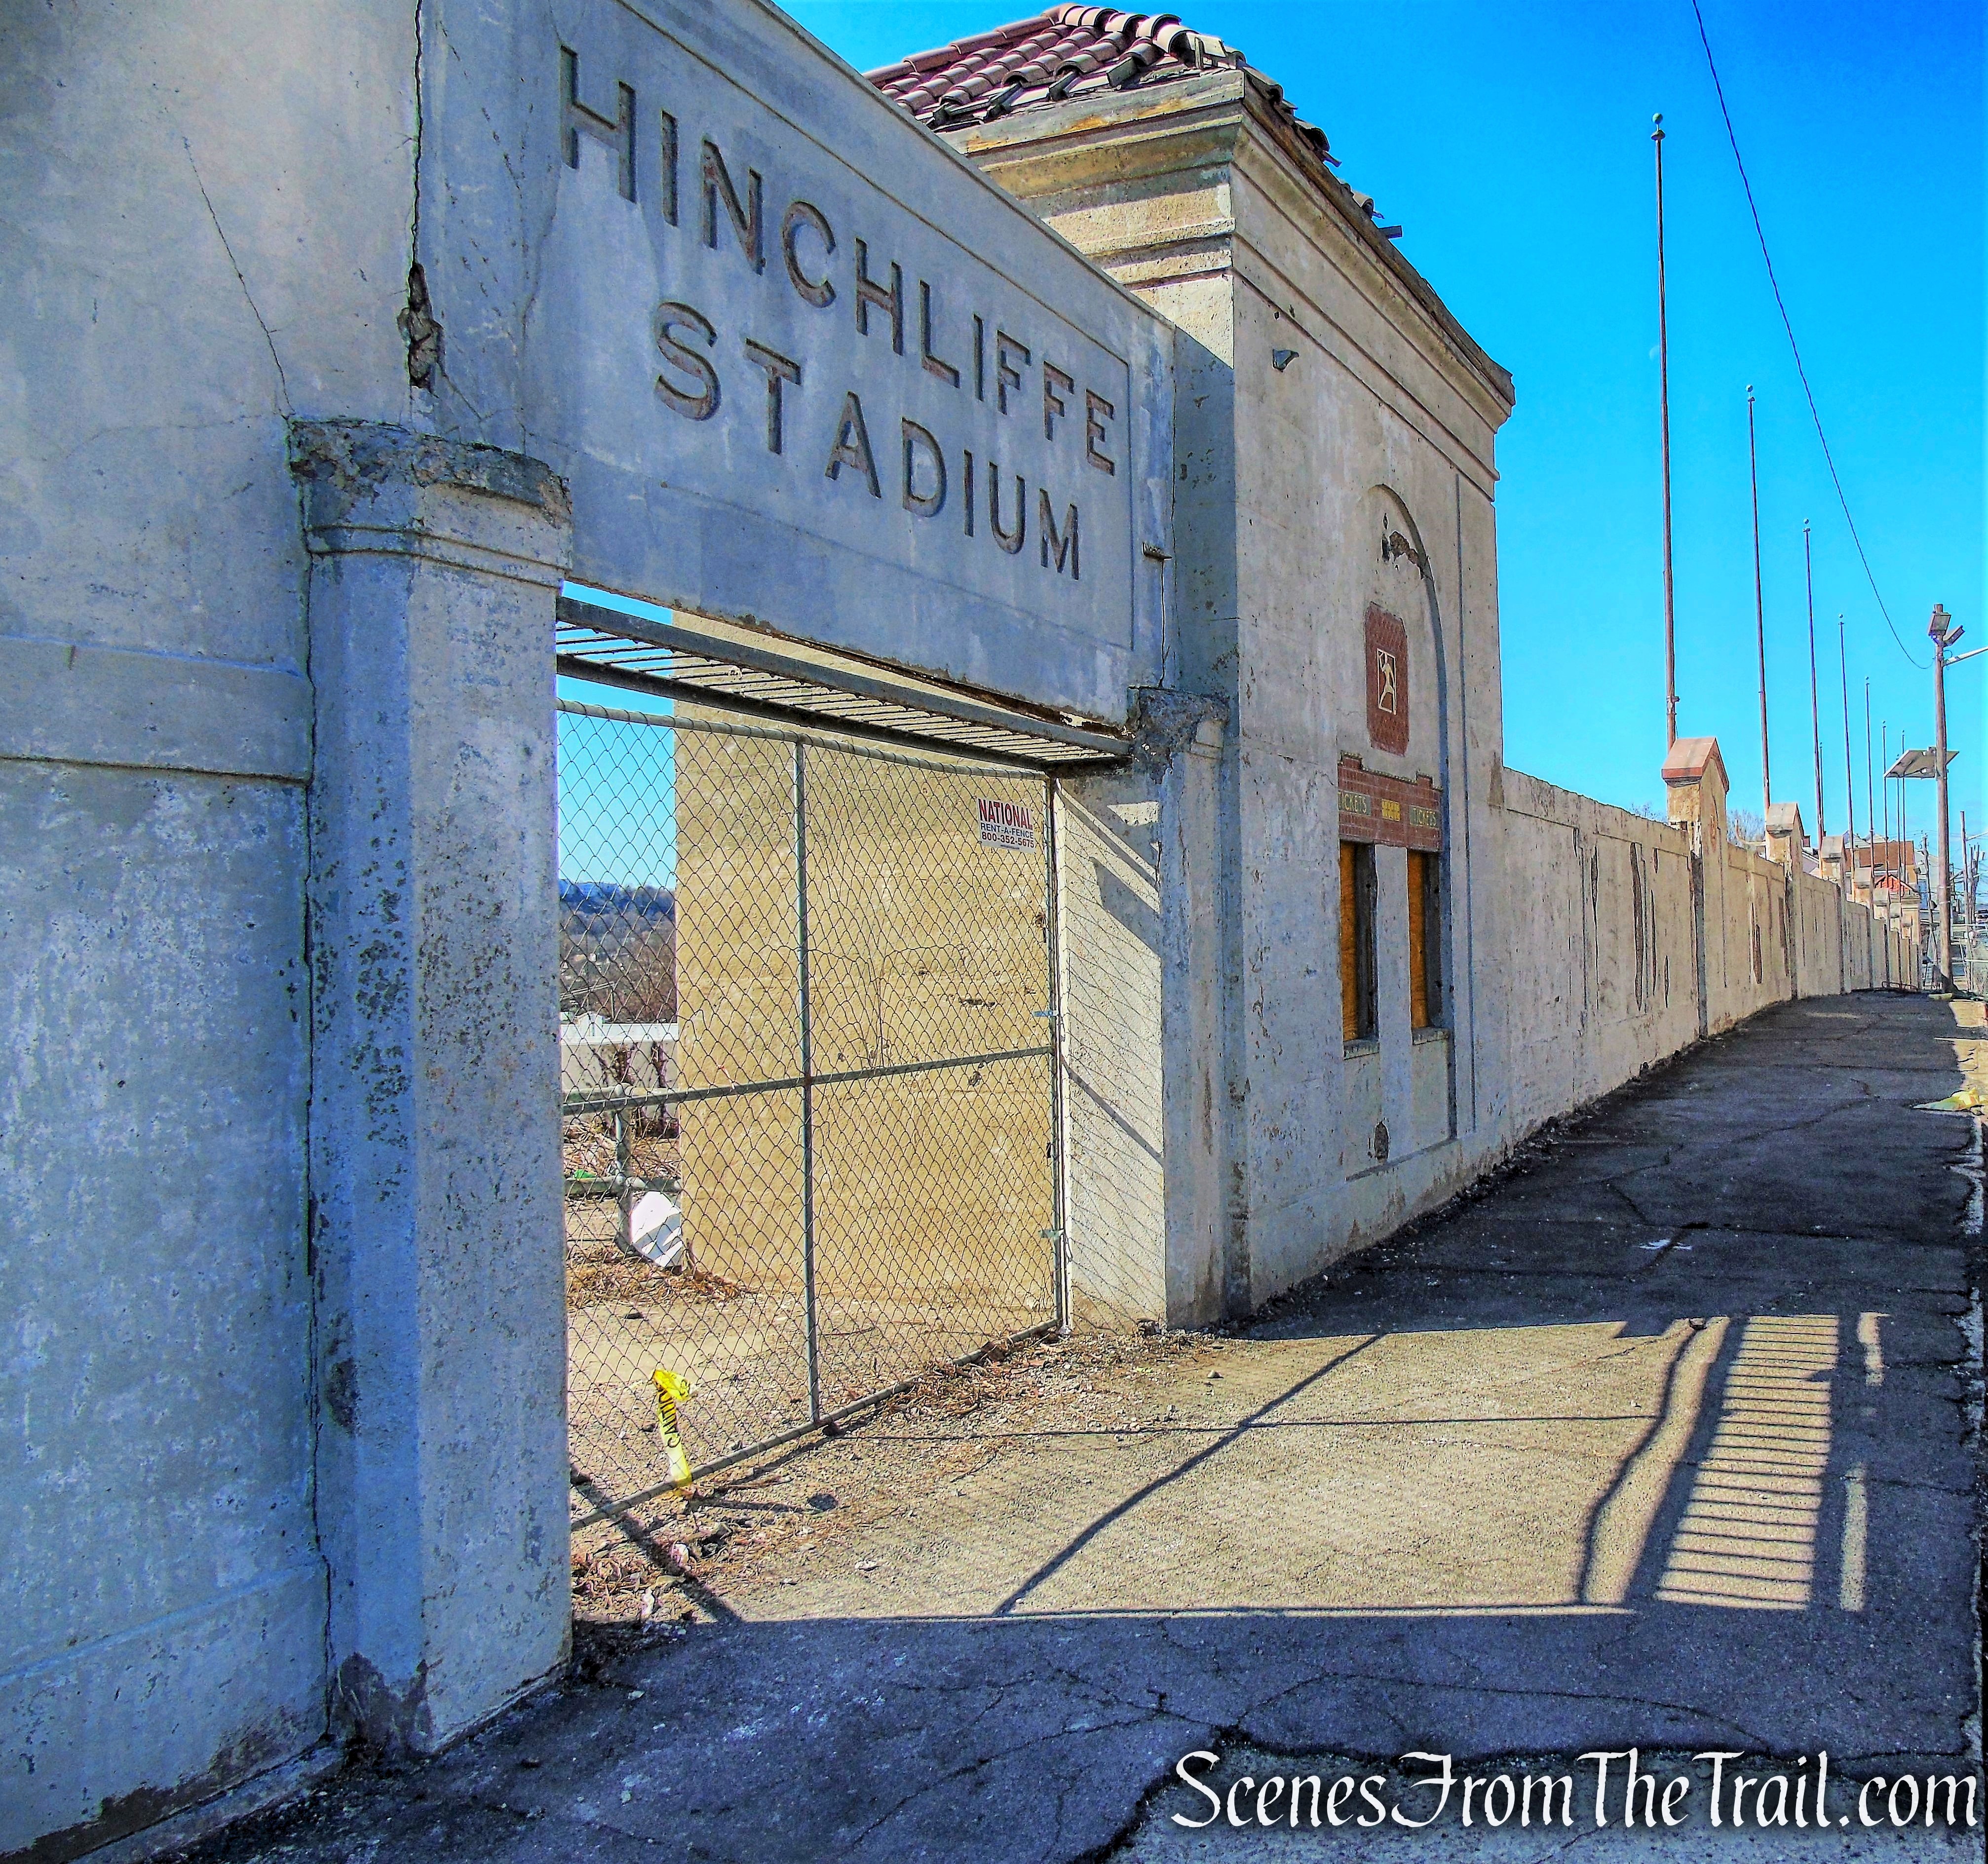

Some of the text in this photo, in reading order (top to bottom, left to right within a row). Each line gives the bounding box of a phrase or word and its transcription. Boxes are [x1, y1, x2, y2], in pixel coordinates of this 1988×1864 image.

[560, 45, 1116, 476] HINCHLIFFE
[655, 301, 1079, 580] STADIUM
[1337, 792, 1367, 813] TICKETS
[978, 799, 1033, 830] NATIONAL
[1413, 808, 1436, 826] TICKETS
[981, 822, 1033, 839] RENT-A-FENCE
[982, 832, 1034, 848] 800-352-5675
